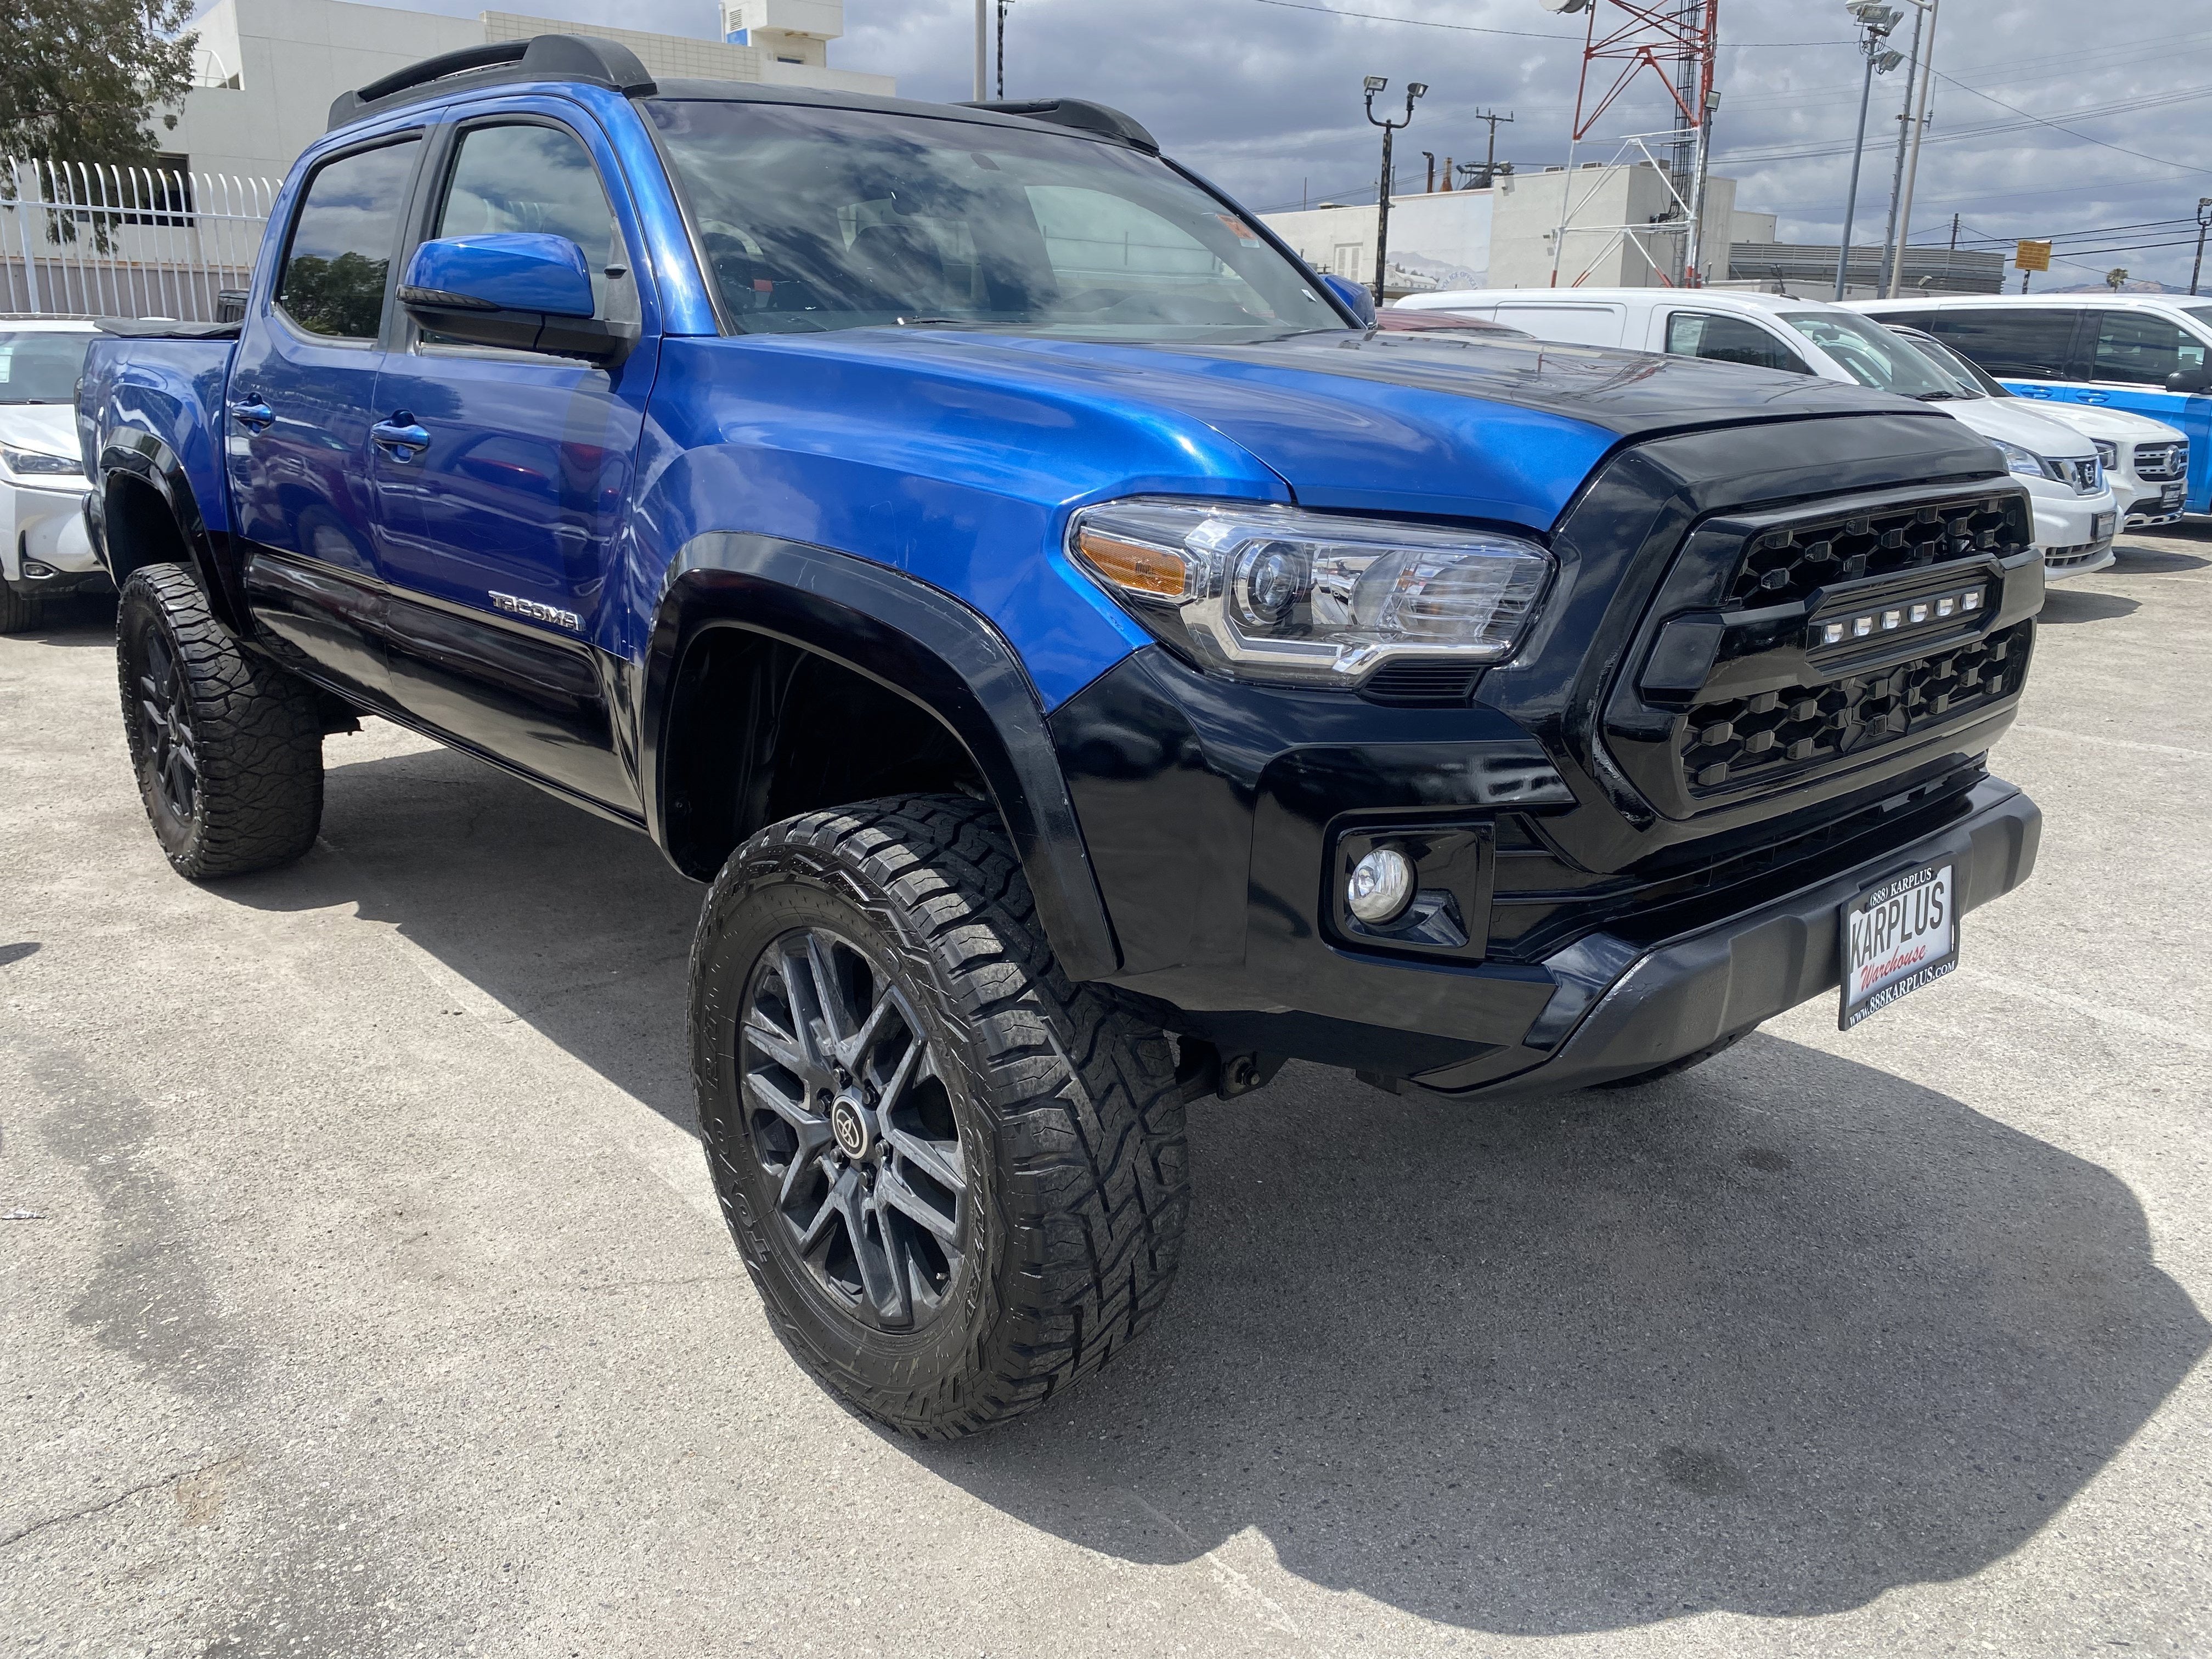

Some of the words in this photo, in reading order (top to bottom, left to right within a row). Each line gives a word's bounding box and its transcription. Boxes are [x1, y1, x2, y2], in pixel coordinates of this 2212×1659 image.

[488, 590, 585, 631] TACOMA
[1869, 886, 1889, 907] (888)
[1891, 867, 1932, 896] KARPLUS
[1850, 881, 1945, 974] KARPLUS
[1860, 945, 1927, 992] Warehouse
[714, 1118, 770, 1263] TOYO
